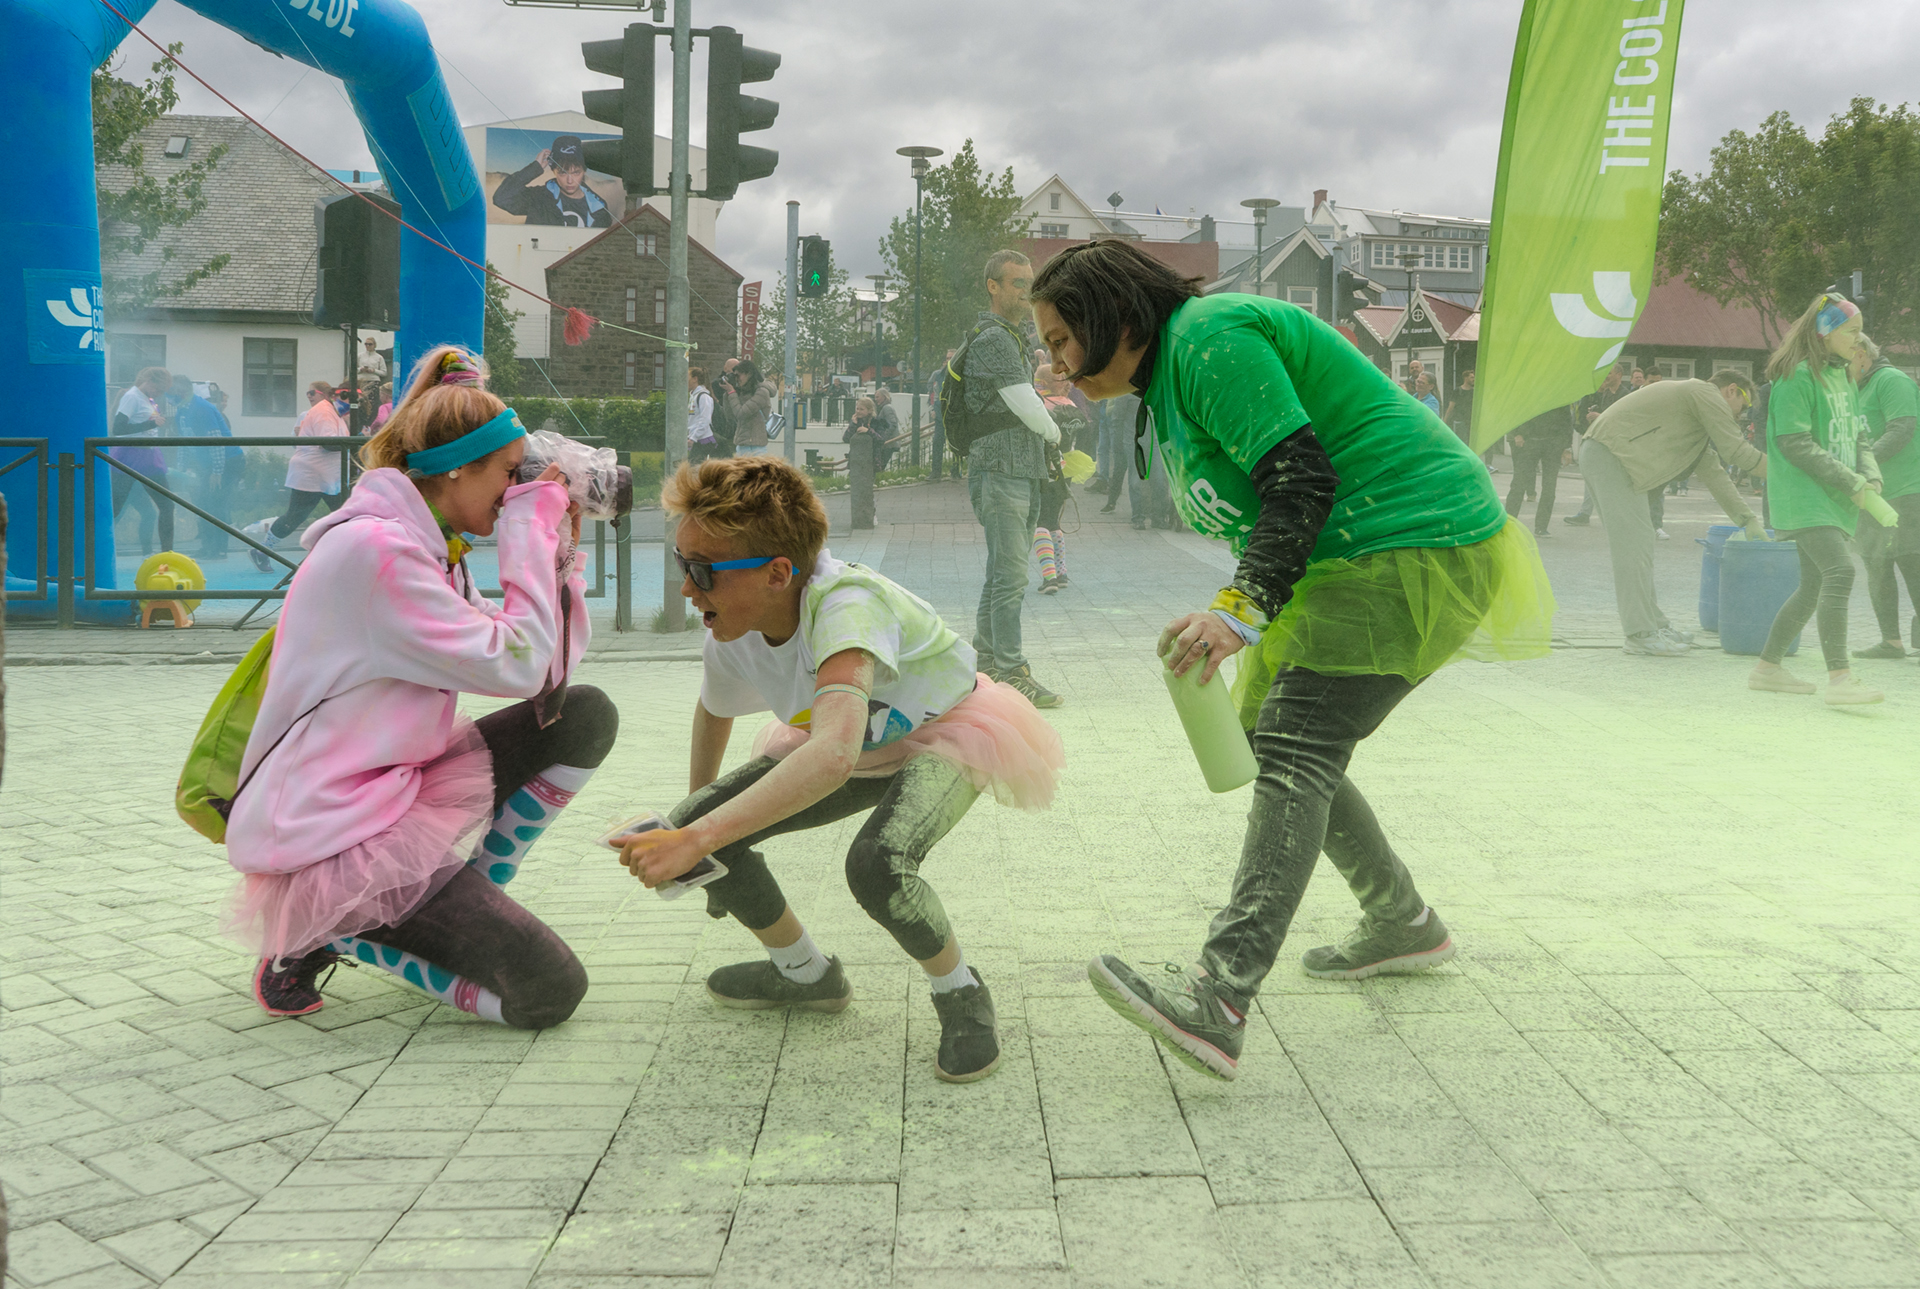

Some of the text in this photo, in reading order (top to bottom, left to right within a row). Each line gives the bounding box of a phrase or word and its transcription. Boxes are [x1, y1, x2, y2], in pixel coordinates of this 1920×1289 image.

[1599, 0, 1668, 174] THE COL
[1826, 392, 1851, 418] THE
[1828, 416, 1858, 443] COLO
